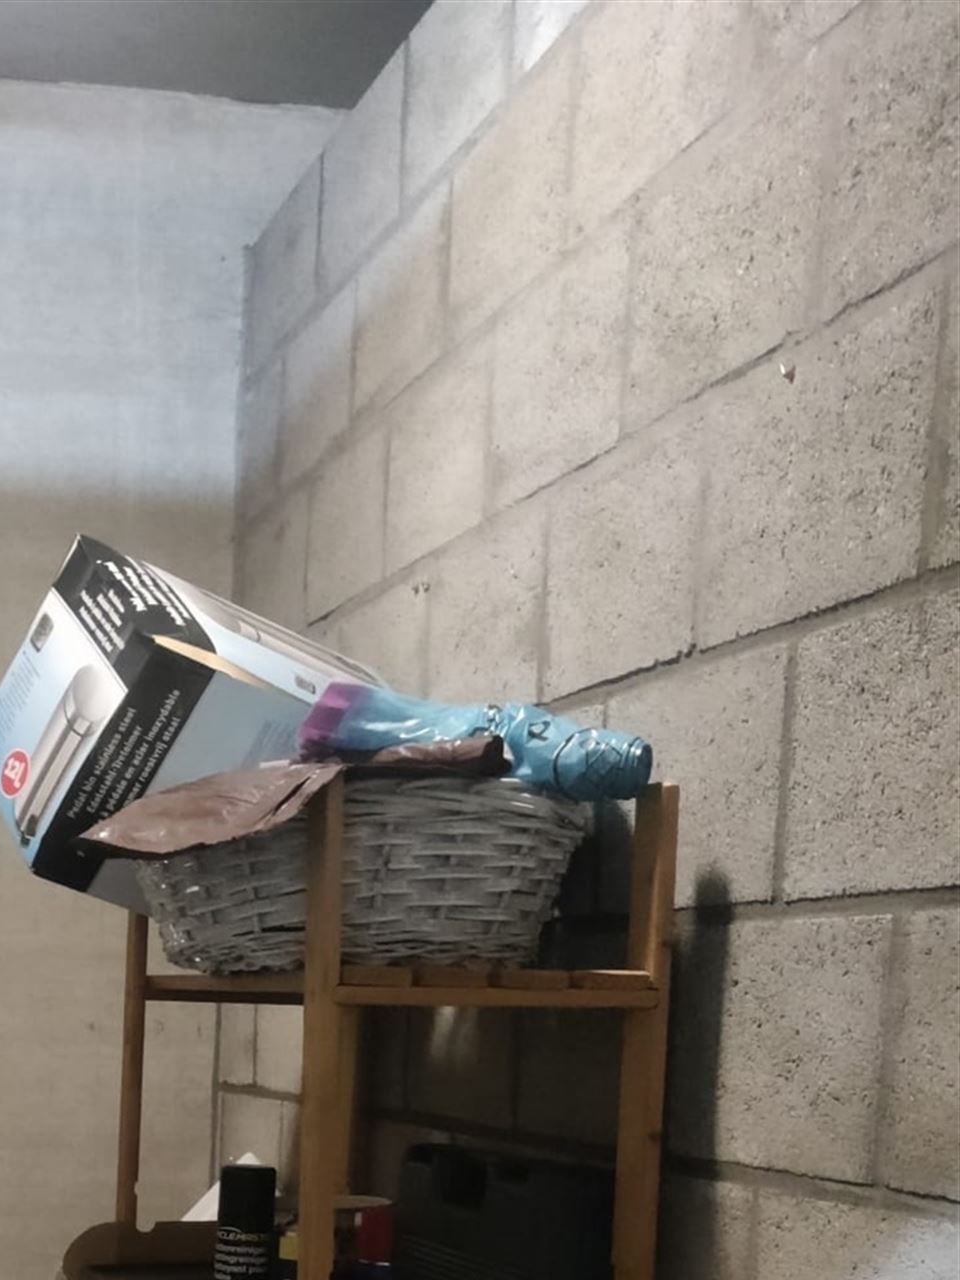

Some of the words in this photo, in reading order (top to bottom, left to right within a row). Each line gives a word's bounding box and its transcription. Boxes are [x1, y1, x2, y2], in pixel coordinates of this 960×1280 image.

[116, 705, 136, 732] steel
[130, 741, 149, 765] acier
[143, 687, 182, 742] inoxydable
[136, 740, 167, 783] roestvrij
[160, 715, 180, 742] staal
